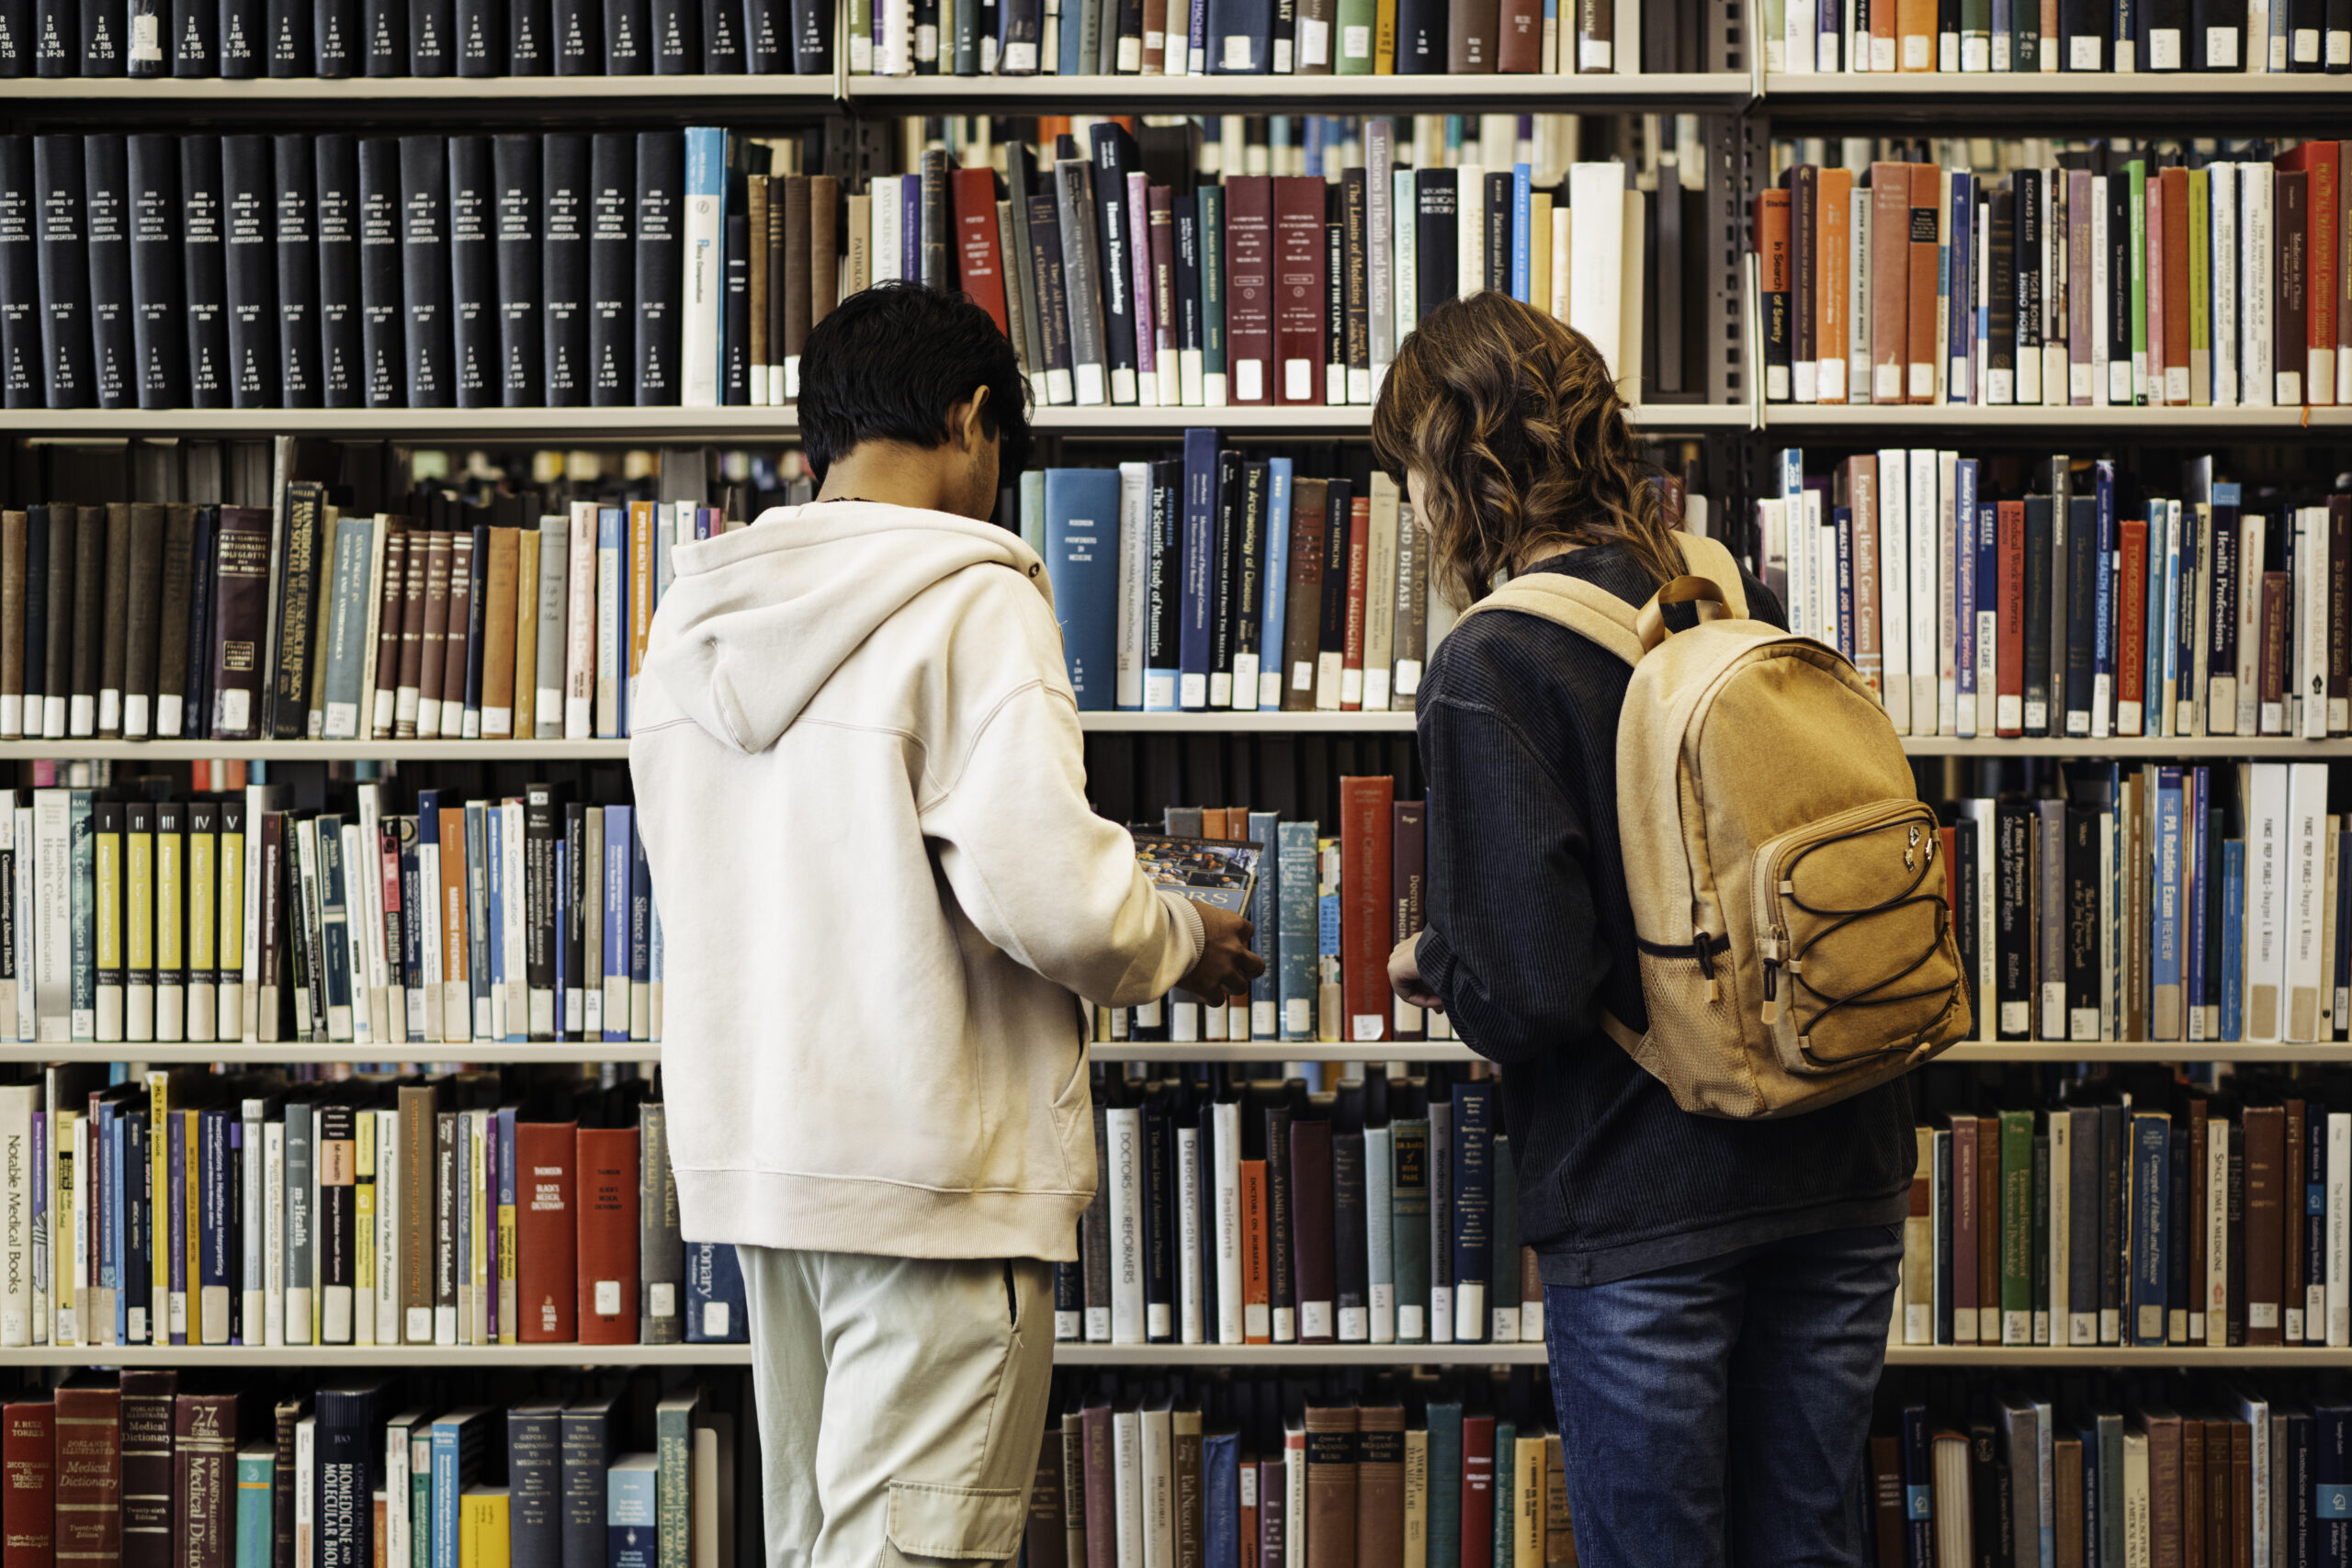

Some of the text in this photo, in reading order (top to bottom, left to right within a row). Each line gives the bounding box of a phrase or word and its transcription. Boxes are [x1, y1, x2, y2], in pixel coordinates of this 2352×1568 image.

[1349, 181, 1362, 305] The Limits of Medicine
[1373, 136, 1386, 315] Milestones in Health and Medicine
[2025, 178, 2033, 242] RICHARD ELLIS
[1107, 202, 1124, 315] Human Paleopathology
[1401, 222, 1413, 322] STORY MEDICINE
[1771, 243, 1782, 344] In Search of Sanity
[2019, 273, 2029, 343] RHINO HORN
[2030, 270, 2039, 332] TIGER BONE
[1962, 507, 1972, 521] Top
[1963, 468, 1972, 505] America's
[638, 512, 647, 636] APPLIED HEALTH COMMUNICATION
[1150, 487, 1164, 656] The Scientific Study of Mummies
[1243, 469, 1260, 612] The Archaeology of Disease
[1398, 512, 1411, 611] AND DISEASE
[1857, 474, 1872, 650] Exploring Health Care Careers
[1962, 523, 1972, 555] Medical,
[281, 501, 304, 671] AND SOCIAL MEASUREMENT
[290, 502, 314, 702] HANDBOOK OF RESEARCH DESIGN
[1348, 544, 1363, 659] ROMAN MEDICINE
[1961, 558, 1972, 595] Education
[2098, 552, 2109, 659] HEALTH PROFESSIONS
[2215, 531, 2228, 651] Health Professions
[1963, 606, 1972, 633] Human
[1963, 636, 1972, 668] Services
[2126, 544, 2139, 697] TOMORROW'S DOCTORS
[1963, 670, 1972, 687] Jobs
[136, 817, 143, 829] II
[162, 816, 175, 829] III
[196, 816, 209, 829] IV
[227, 816, 238, 829] V
[2015, 828, 2023, 853] Black
[509, 850, 518, 926] Communication
[2002, 817, 2013, 931] Struggle for Civil Rights
[2013, 856, 2024, 907] Physician's
[2162, 798, 2177, 961] THE PA Rotation Exam REVIEW
[2, 854, 13, 976] Communicating About Health
[75, 818, 86, 1009] Health Communication in Practice
[634, 897, 646, 970] Silence Kills
[2008, 953, 2018, 989] Ridlon
[643, 1115, 662, 1195] Dictionary
[1184, 1140, 1193, 1210] DEMOCRACY
[8, 1134, 21, 1293] Notable Medical Books
[294, 1188, 306, 1247] m-Health
[441, 1151, 451, 1296] Telemedicine and Telehealth
[1224, 1188, 1233, 1258] Residents
[1251, 1219, 1258, 1230] ON
[1436, 1149, 1446, 1284] Wondrous Transformations
[2213, 1226, 2222, 1271] MEDICINE
[215, 1227, 224, 1275] Interpreting
[122, 1433, 170, 1444] Dictionary
[130, 1422, 166, 1431] Medical
[192, 1427, 219, 1437] Edition
[60, 1476, 117, 1489] Dictionary
[66, 1461, 110, 1472] Medical
[191, 1458, 206, 1517] Medical
[324, 1463, 337, 1536] MOLECULAR
[2299, 1448, 2307, 1495] Biomedicine
[339, 1463, 353, 1564] BIOMEDICINE AND
[1181, 1474, 1196, 1545] Pat Nixon of
